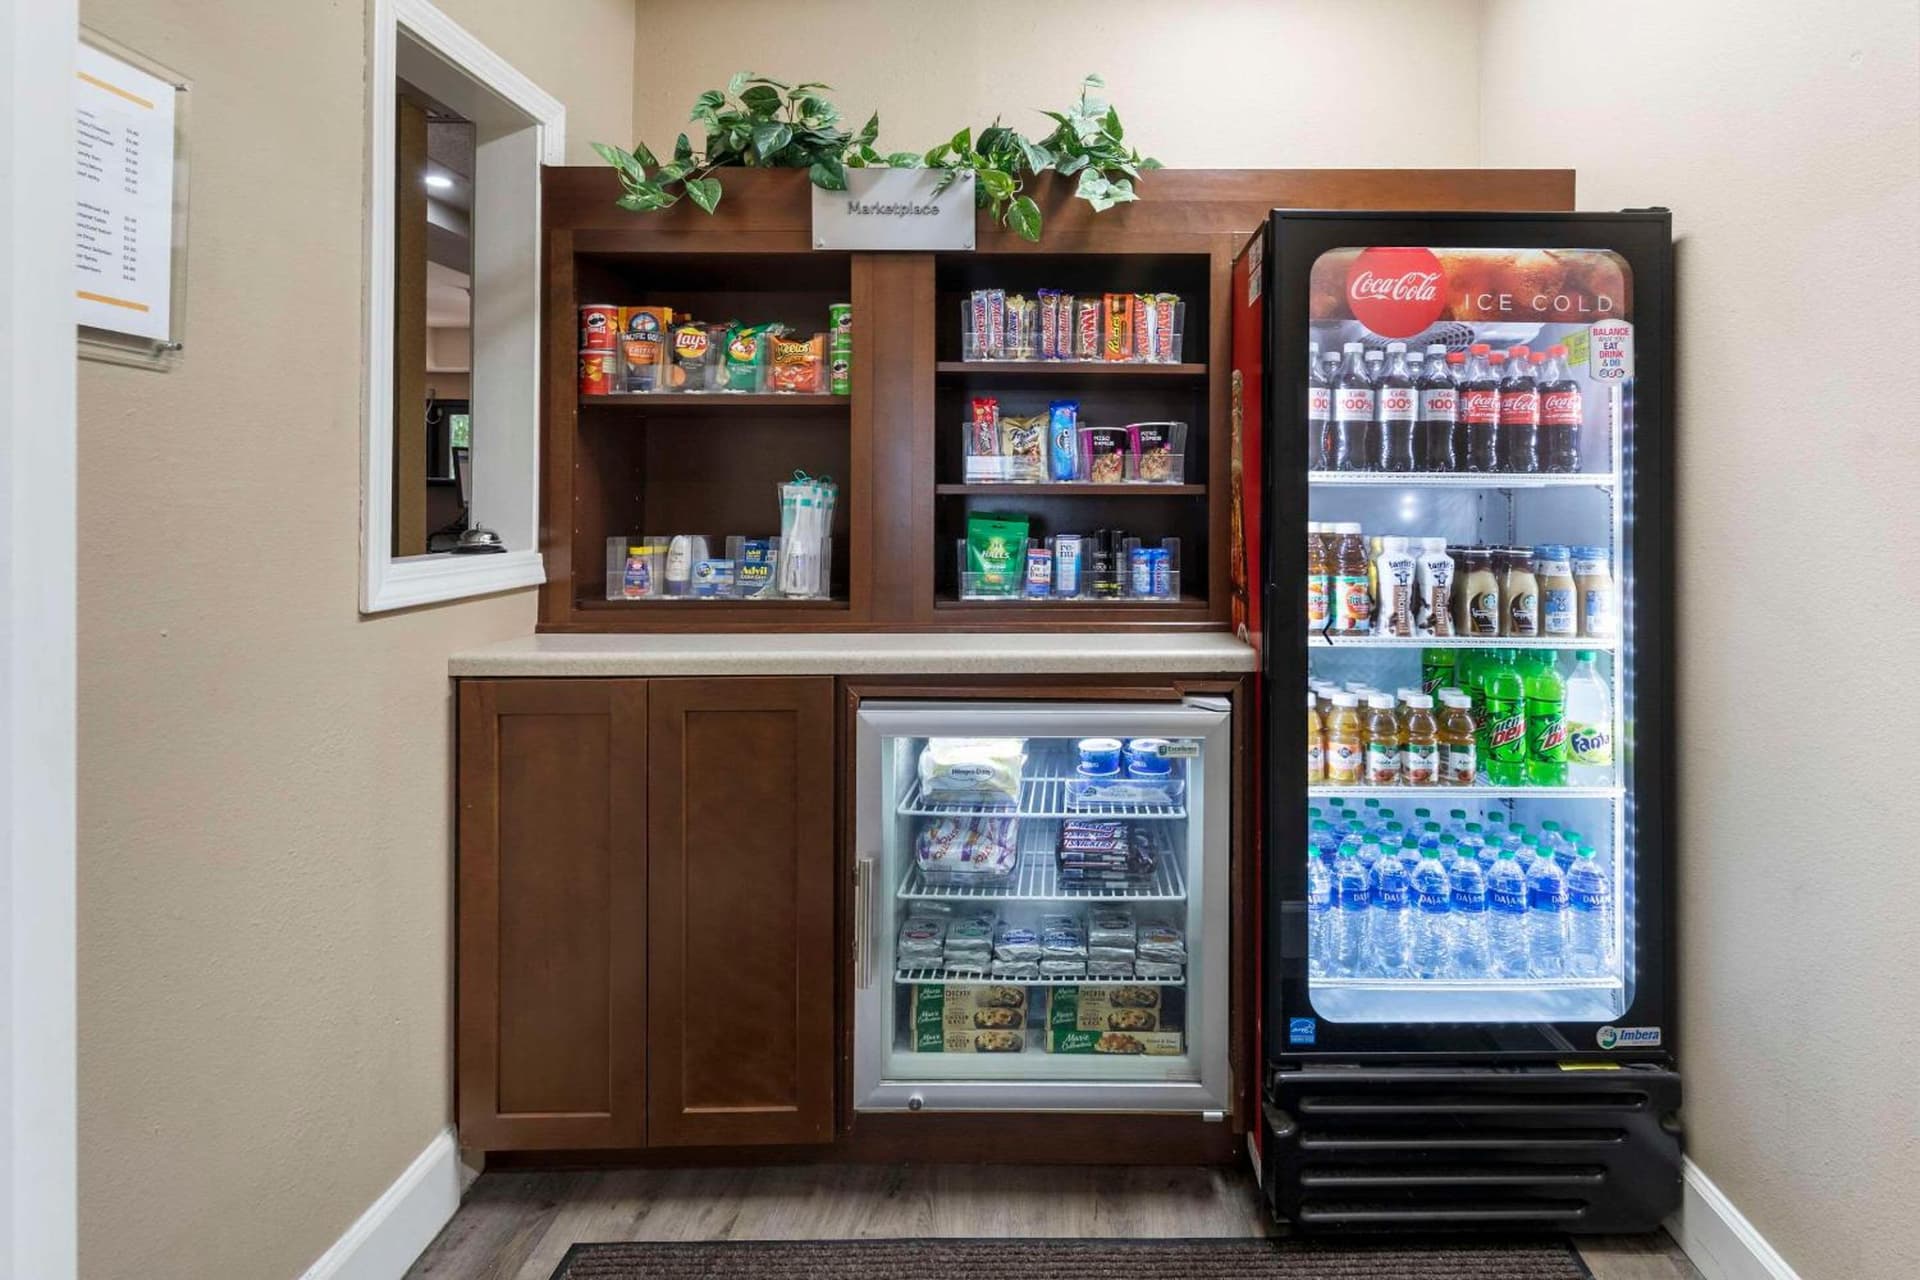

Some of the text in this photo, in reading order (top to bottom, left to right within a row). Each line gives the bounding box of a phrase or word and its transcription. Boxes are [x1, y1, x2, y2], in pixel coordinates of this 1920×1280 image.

[848, 201, 940, 218] Marketplace
[1351, 271, 1442, 300] Coca-Cola
[1464, 293, 1613, 312] ICE COLD
[1592, 327, 1630, 336] BALANCE
[1603, 342, 1618, 350] EAT
[1600, 350, 1624, 359] DRINK
[740, 566, 768, 575] Advil
[1619, 1029, 1660, 1040] Imbera
